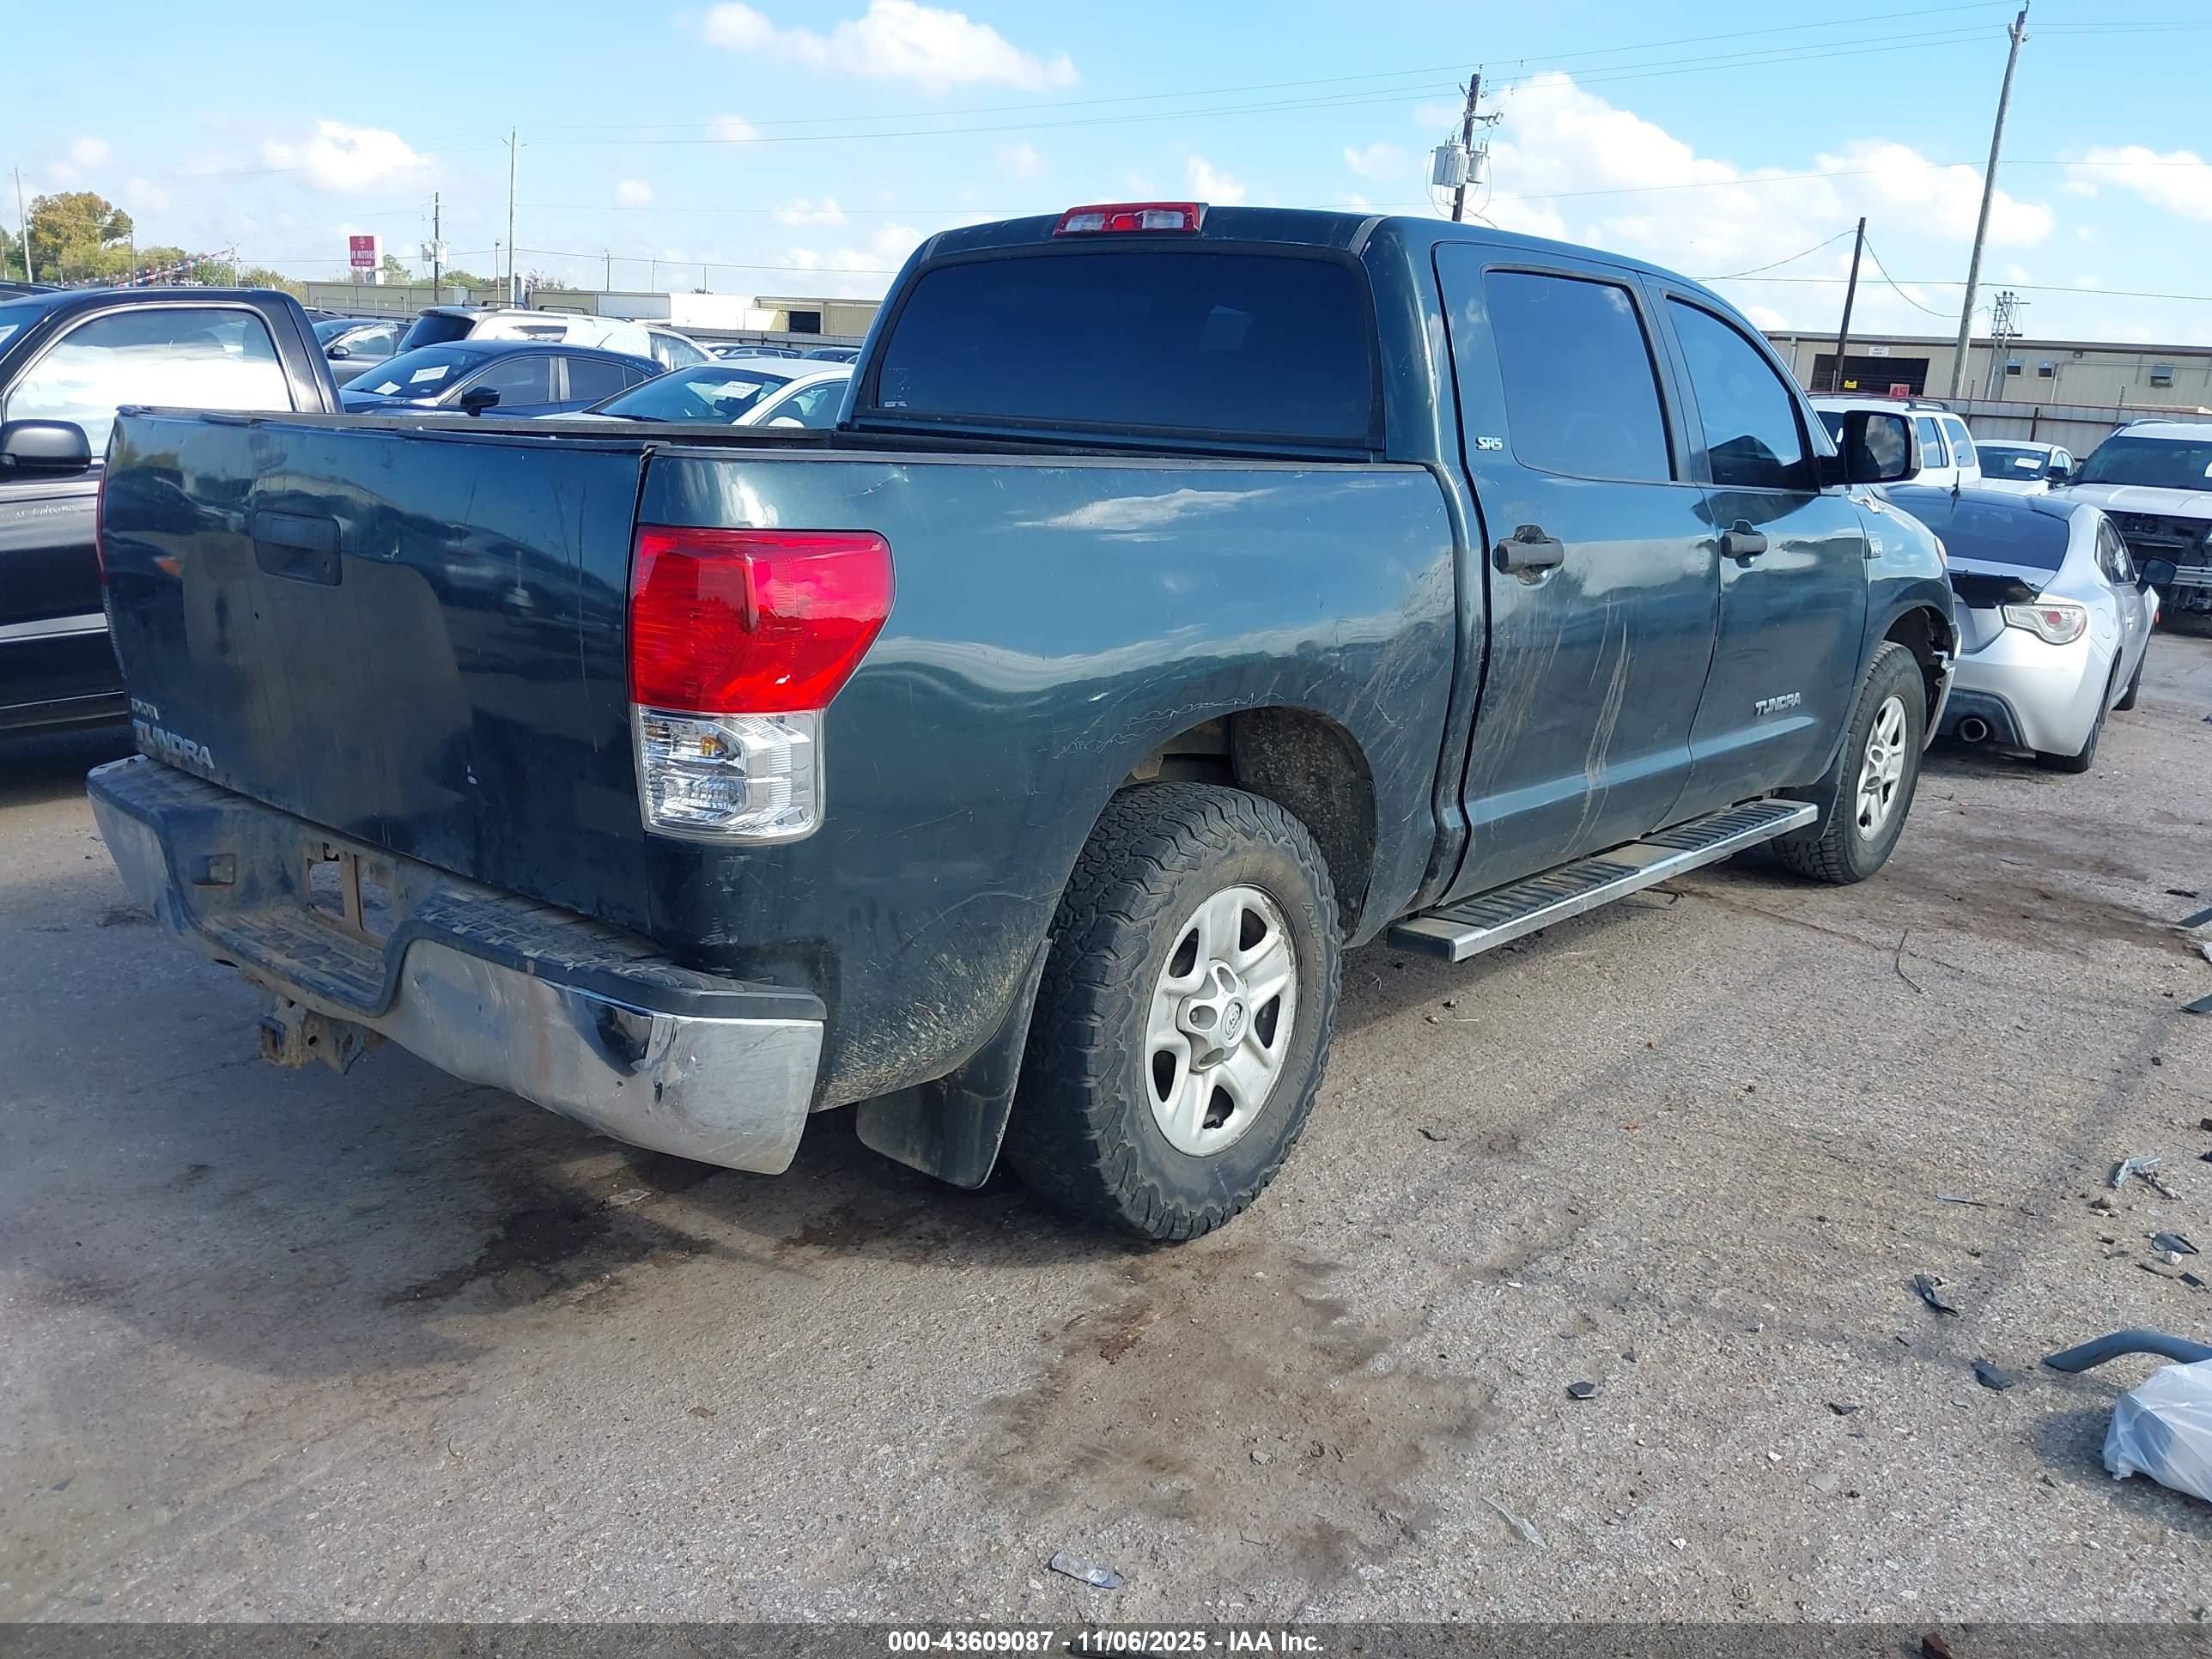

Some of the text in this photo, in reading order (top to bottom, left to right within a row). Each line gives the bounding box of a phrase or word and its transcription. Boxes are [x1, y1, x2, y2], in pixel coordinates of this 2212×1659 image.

[1477, 436, 1504, 451] SR5
[1754, 691, 1801, 716] TUNDRA
[133, 719, 215, 769] TUNDRA
